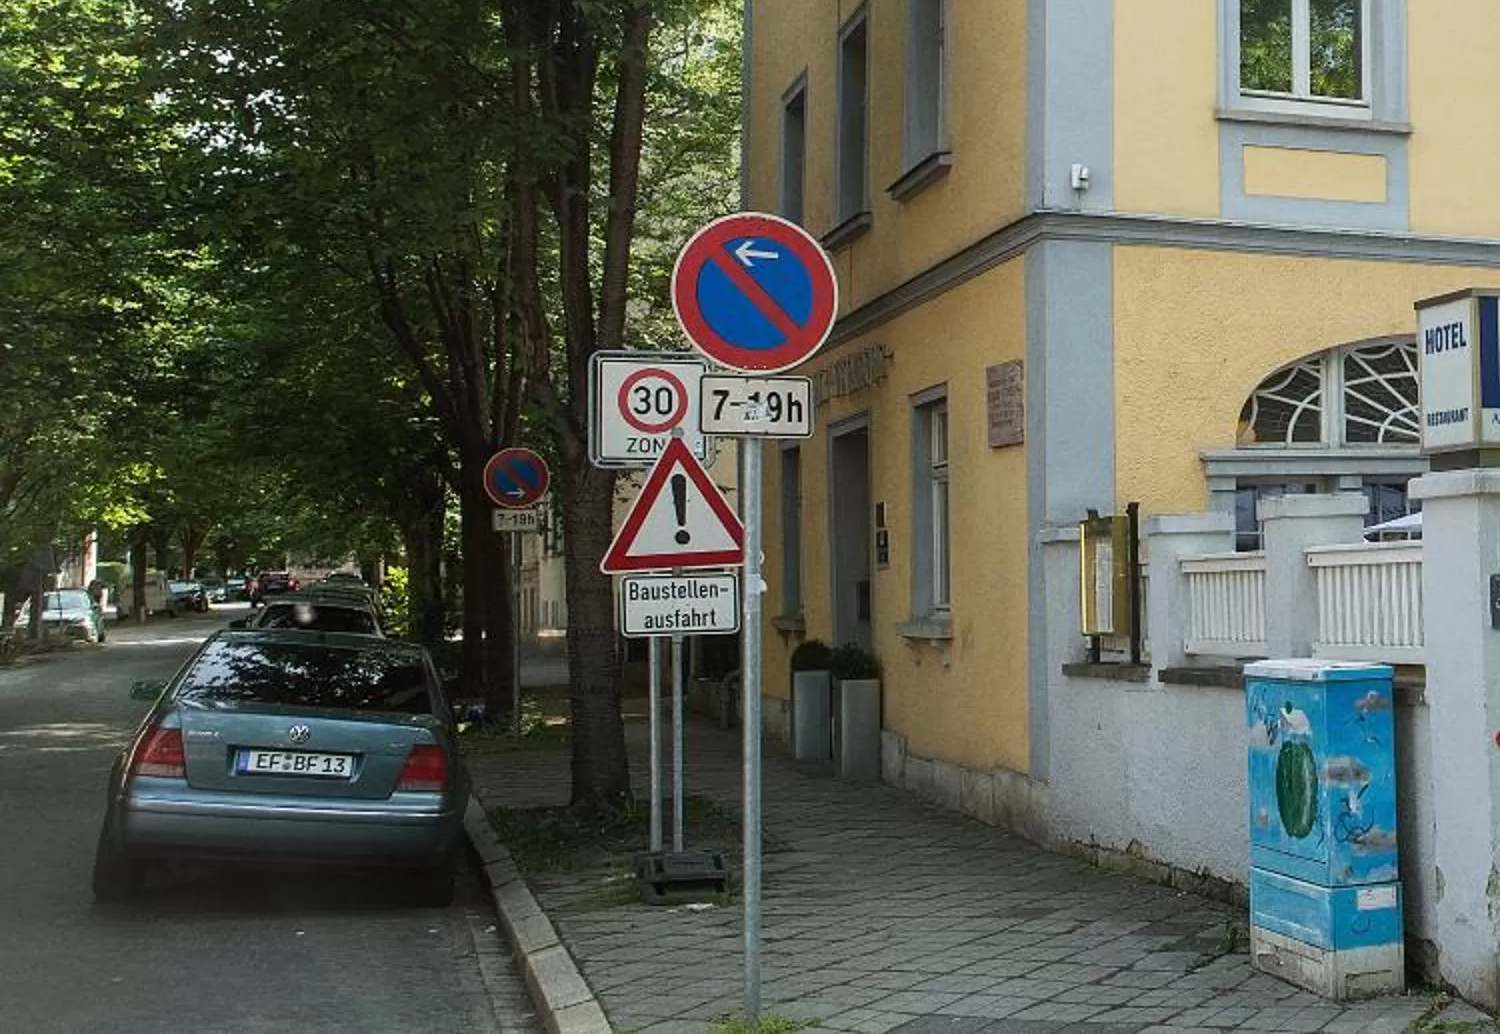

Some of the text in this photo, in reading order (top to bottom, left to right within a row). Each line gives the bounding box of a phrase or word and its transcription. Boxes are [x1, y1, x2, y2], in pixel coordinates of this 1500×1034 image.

[1425, 321, 1467, 355] HOTEL
[633, 386, 673, 415] 30
[626, 437, 666, 453] ZON
[629, 580, 729, 601] Baustellen-
[645, 607, 717, 628] ausfahrt
[256, 753, 345, 773] EF BF 13
